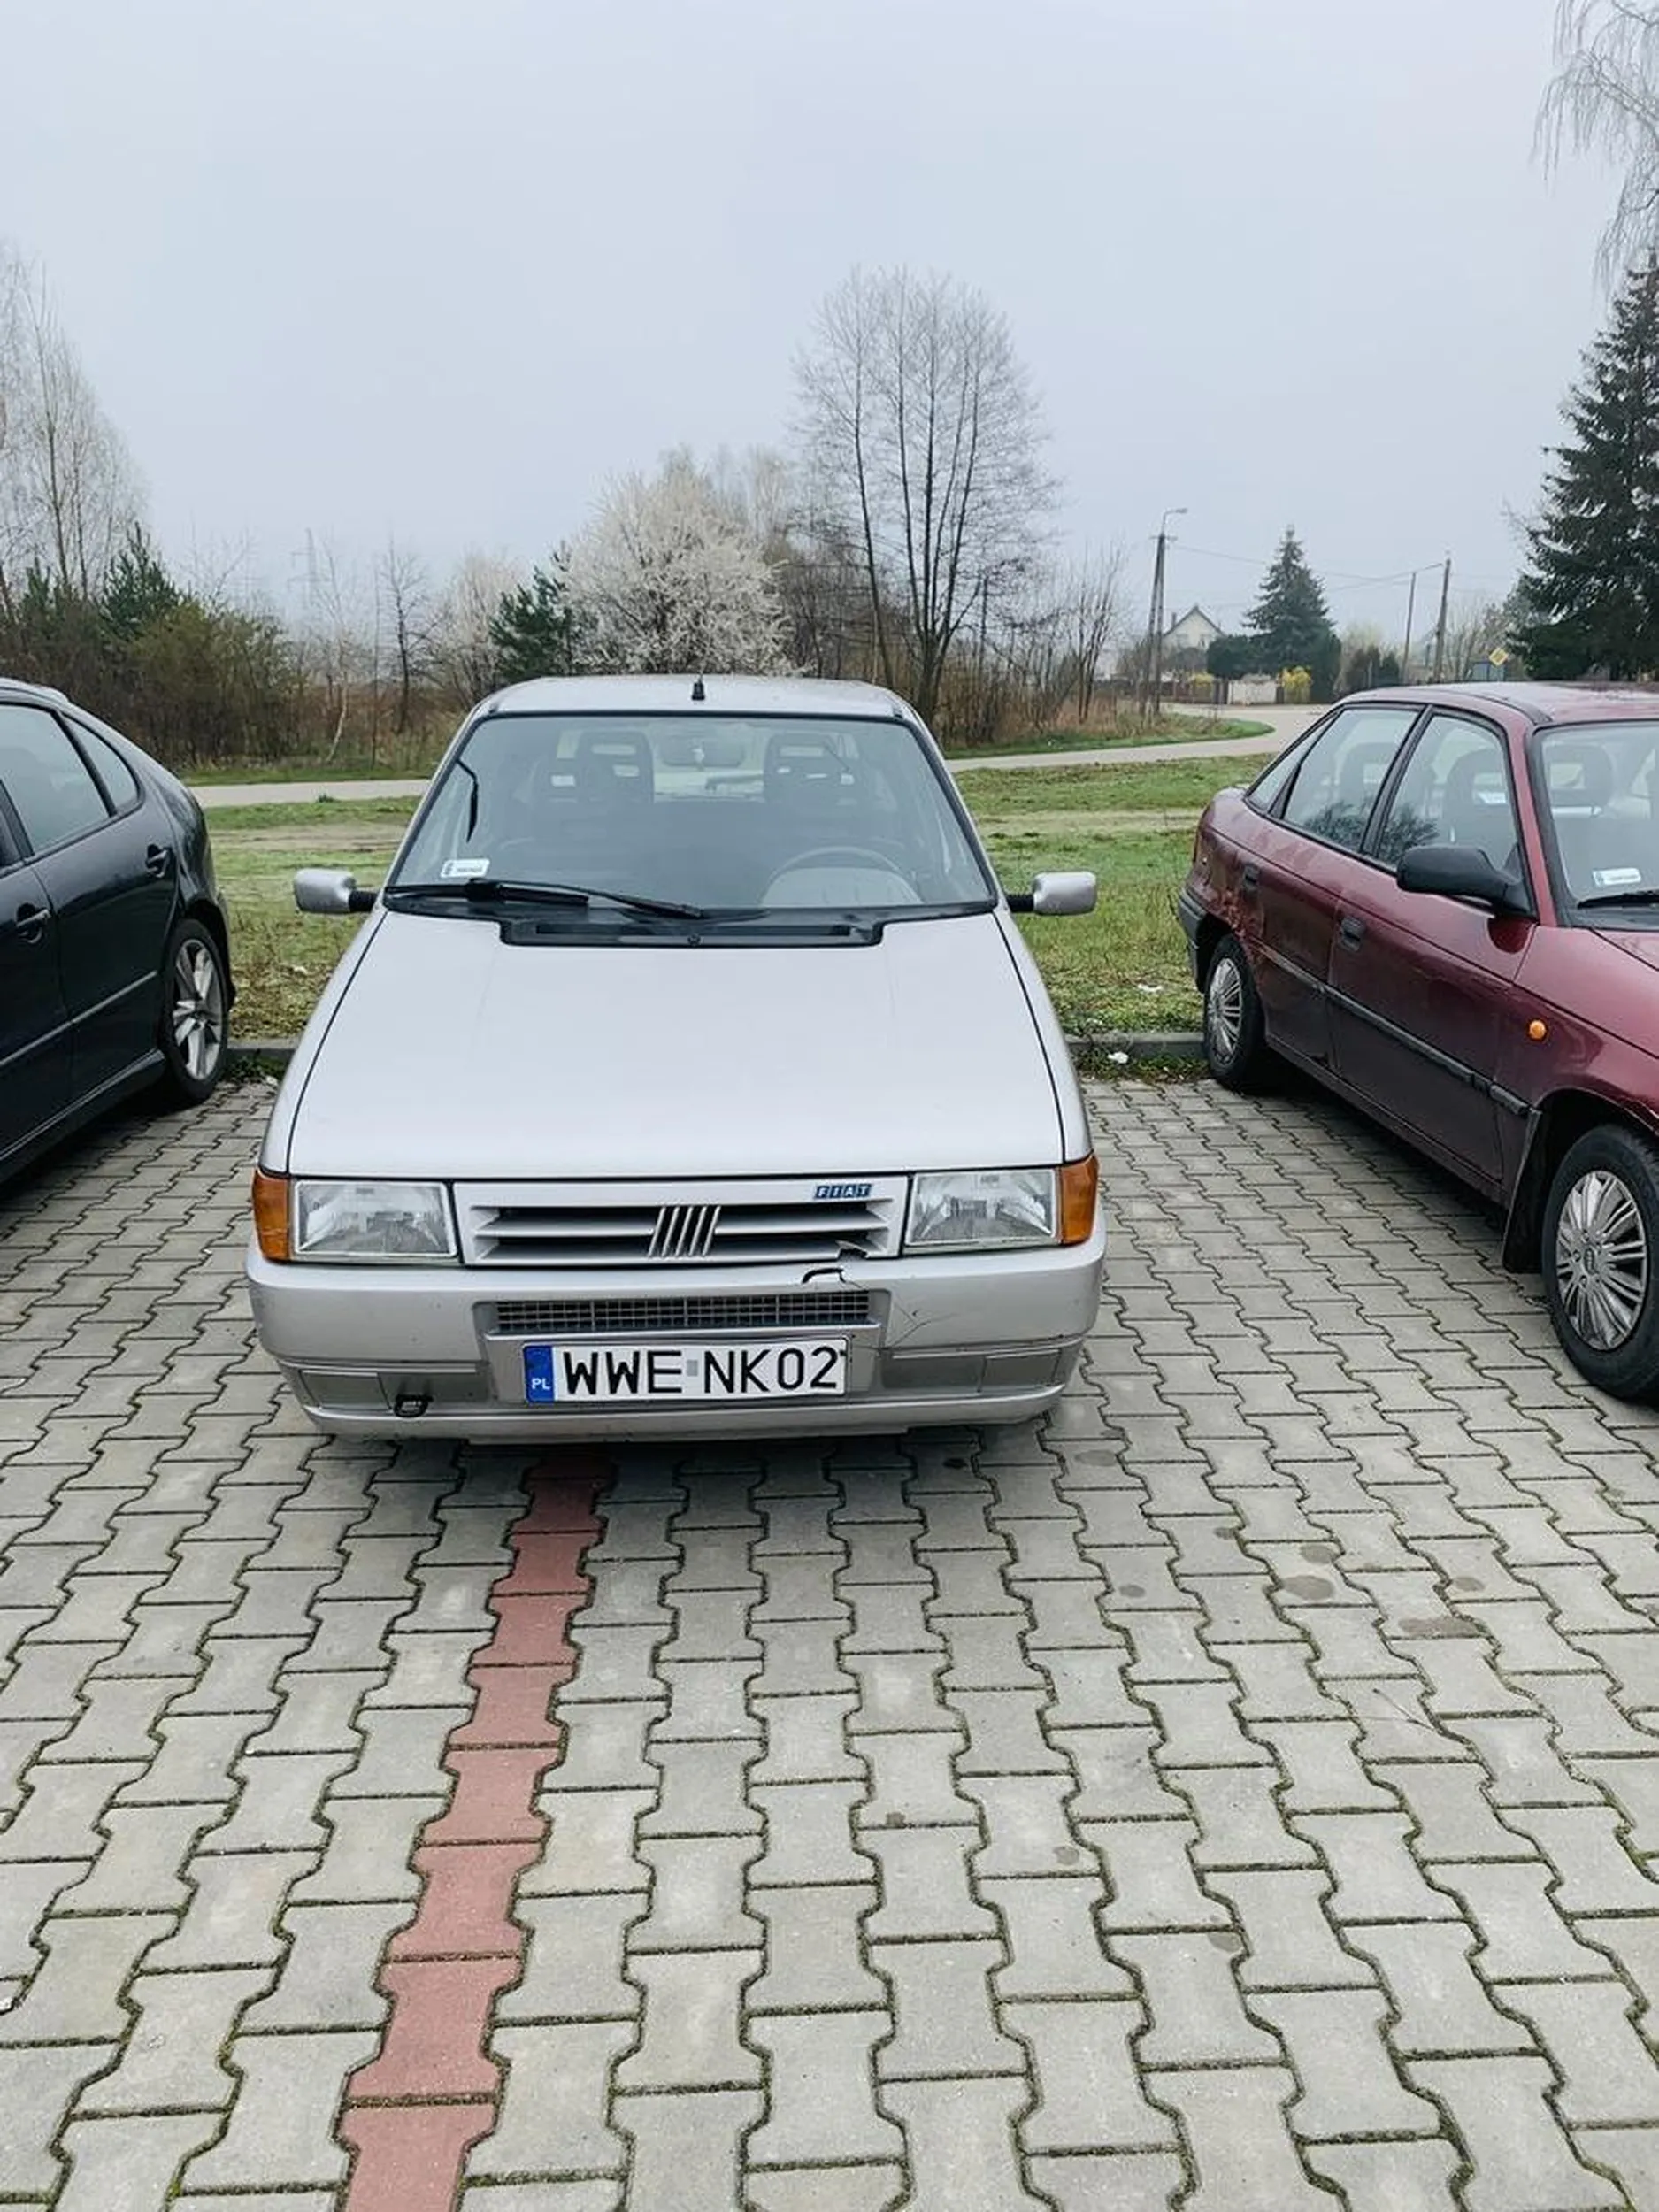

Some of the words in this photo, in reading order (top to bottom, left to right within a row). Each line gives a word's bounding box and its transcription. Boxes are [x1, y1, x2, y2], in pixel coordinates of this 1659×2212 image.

[817, 1186, 869, 1198] FIAT
[563, 1349, 683, 1395] WWE
[703, 1346, 839, 1394] NK02
[532, 1378, 551, 1390] PL
